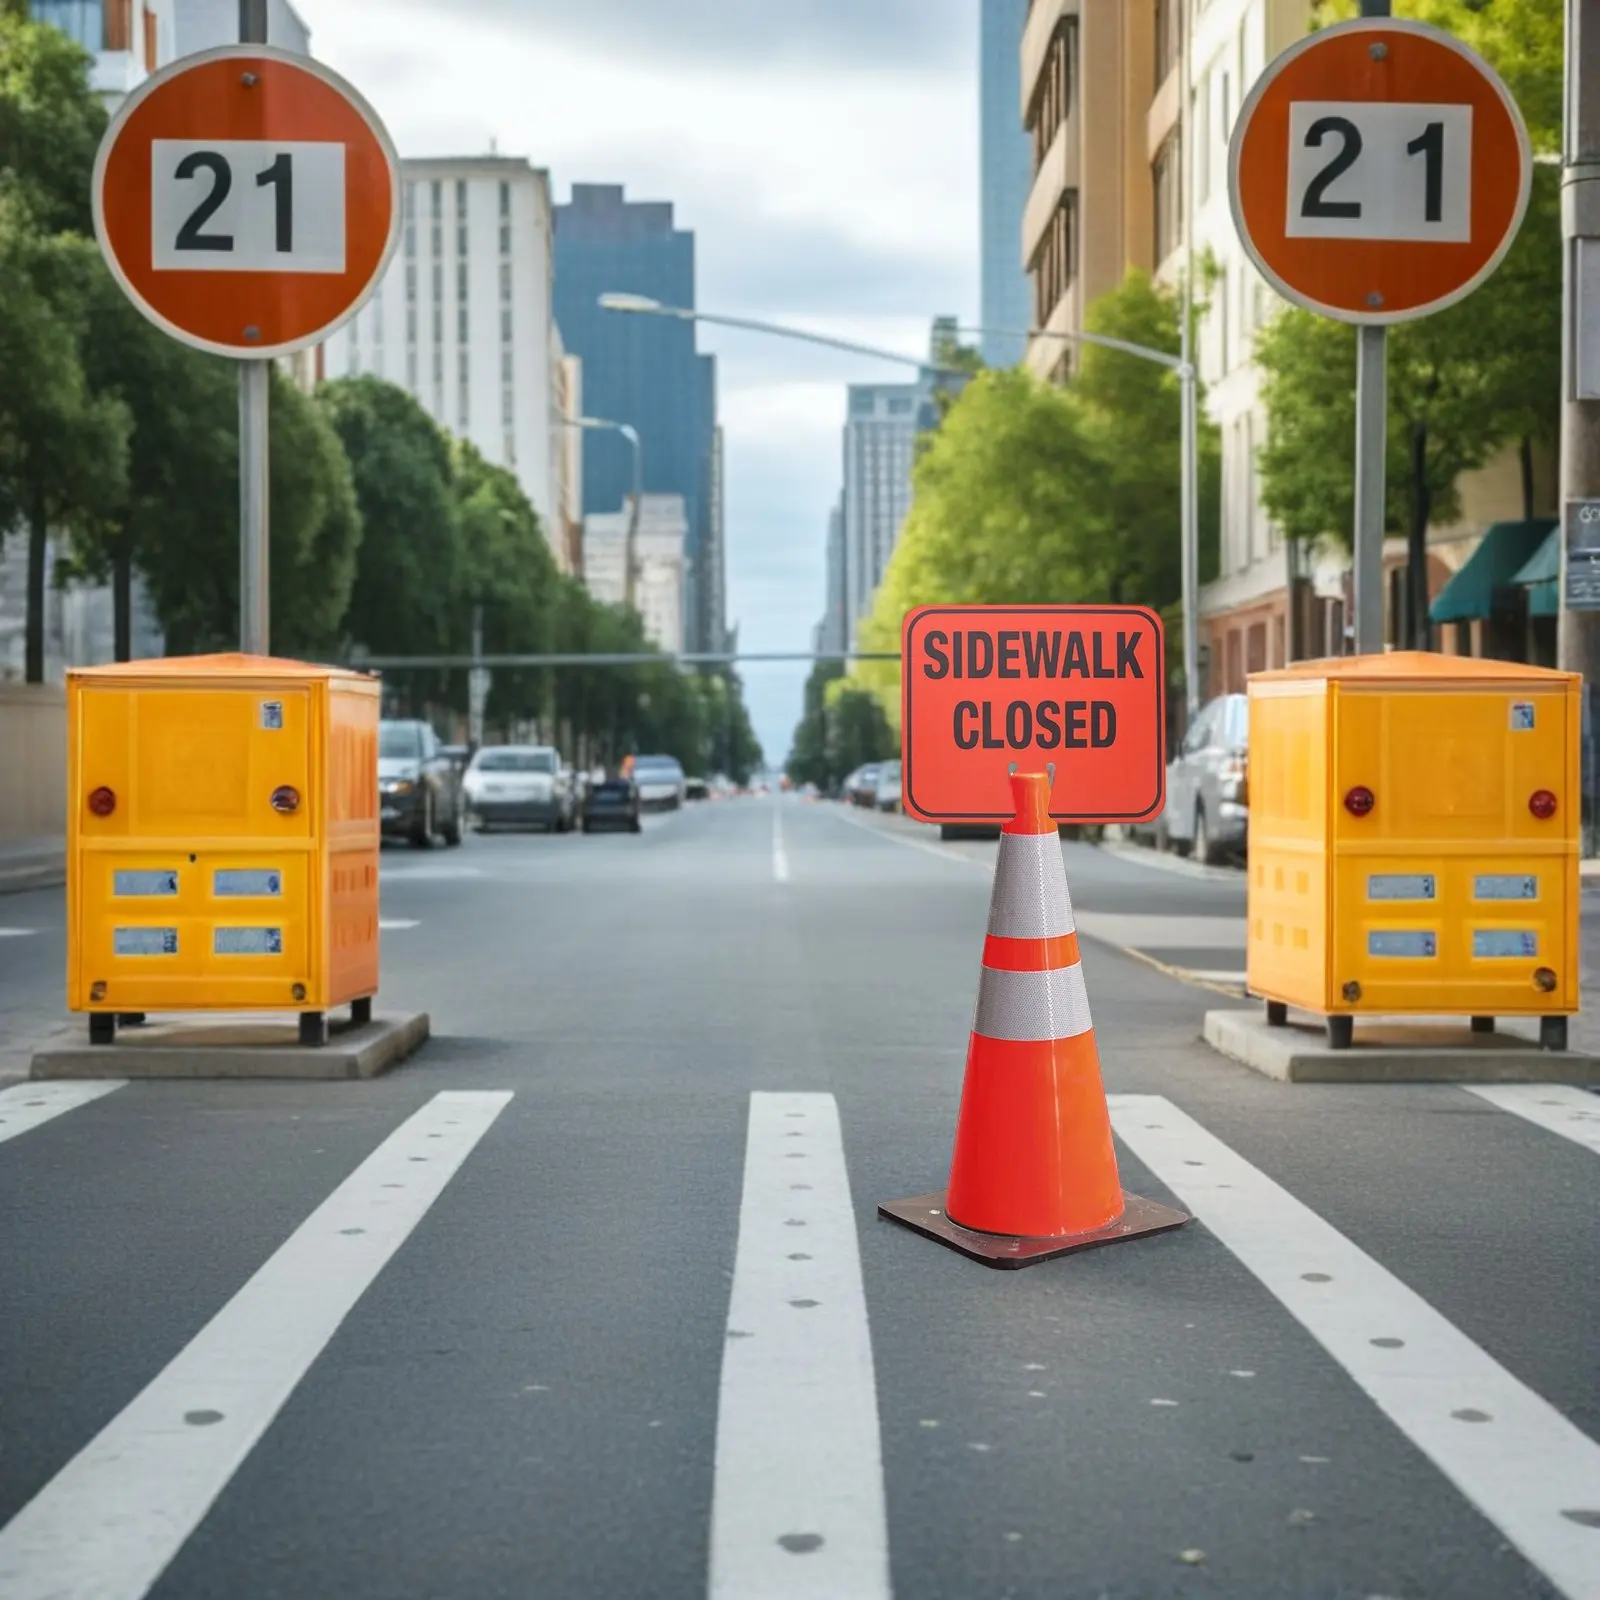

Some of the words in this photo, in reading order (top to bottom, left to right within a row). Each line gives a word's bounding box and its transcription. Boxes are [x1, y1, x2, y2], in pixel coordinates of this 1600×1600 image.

[173, 150, 293, 253] 21
[923, 630, 1144, 680] SIDEWALK
[953, 700, 1117, 750] CLOSED
